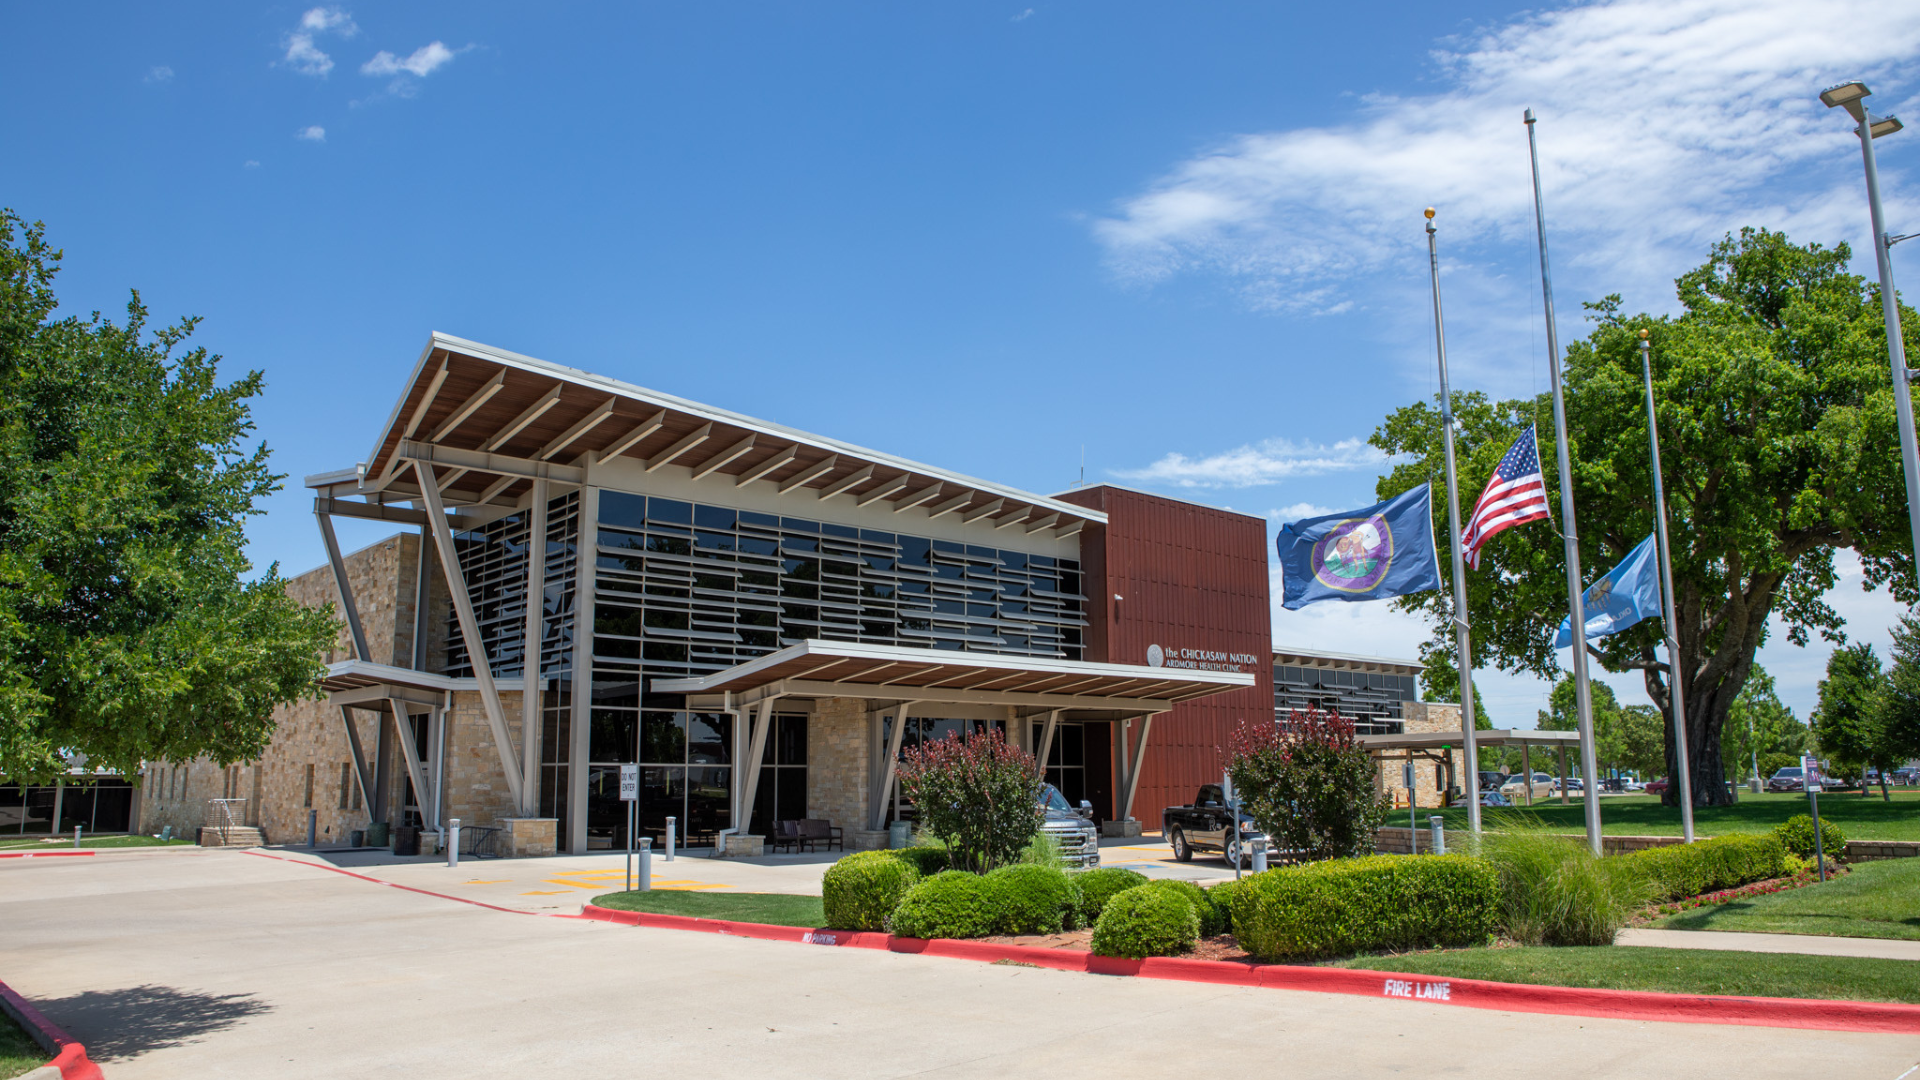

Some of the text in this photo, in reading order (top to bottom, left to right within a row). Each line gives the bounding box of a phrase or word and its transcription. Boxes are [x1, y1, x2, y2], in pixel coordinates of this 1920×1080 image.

[1165, 647, 1257, 664] the CHICKASAW NATION
[1166, 660, 1241, 672] ARDMORE HEALTH CLINIC
[621, 773, 637, 781] DO NOT
[622, 783, 635, 791] ENTER
[802, 932, 836, 945] NO PARKING
[1384, 979, 1450, 1000] FIRE LANE
